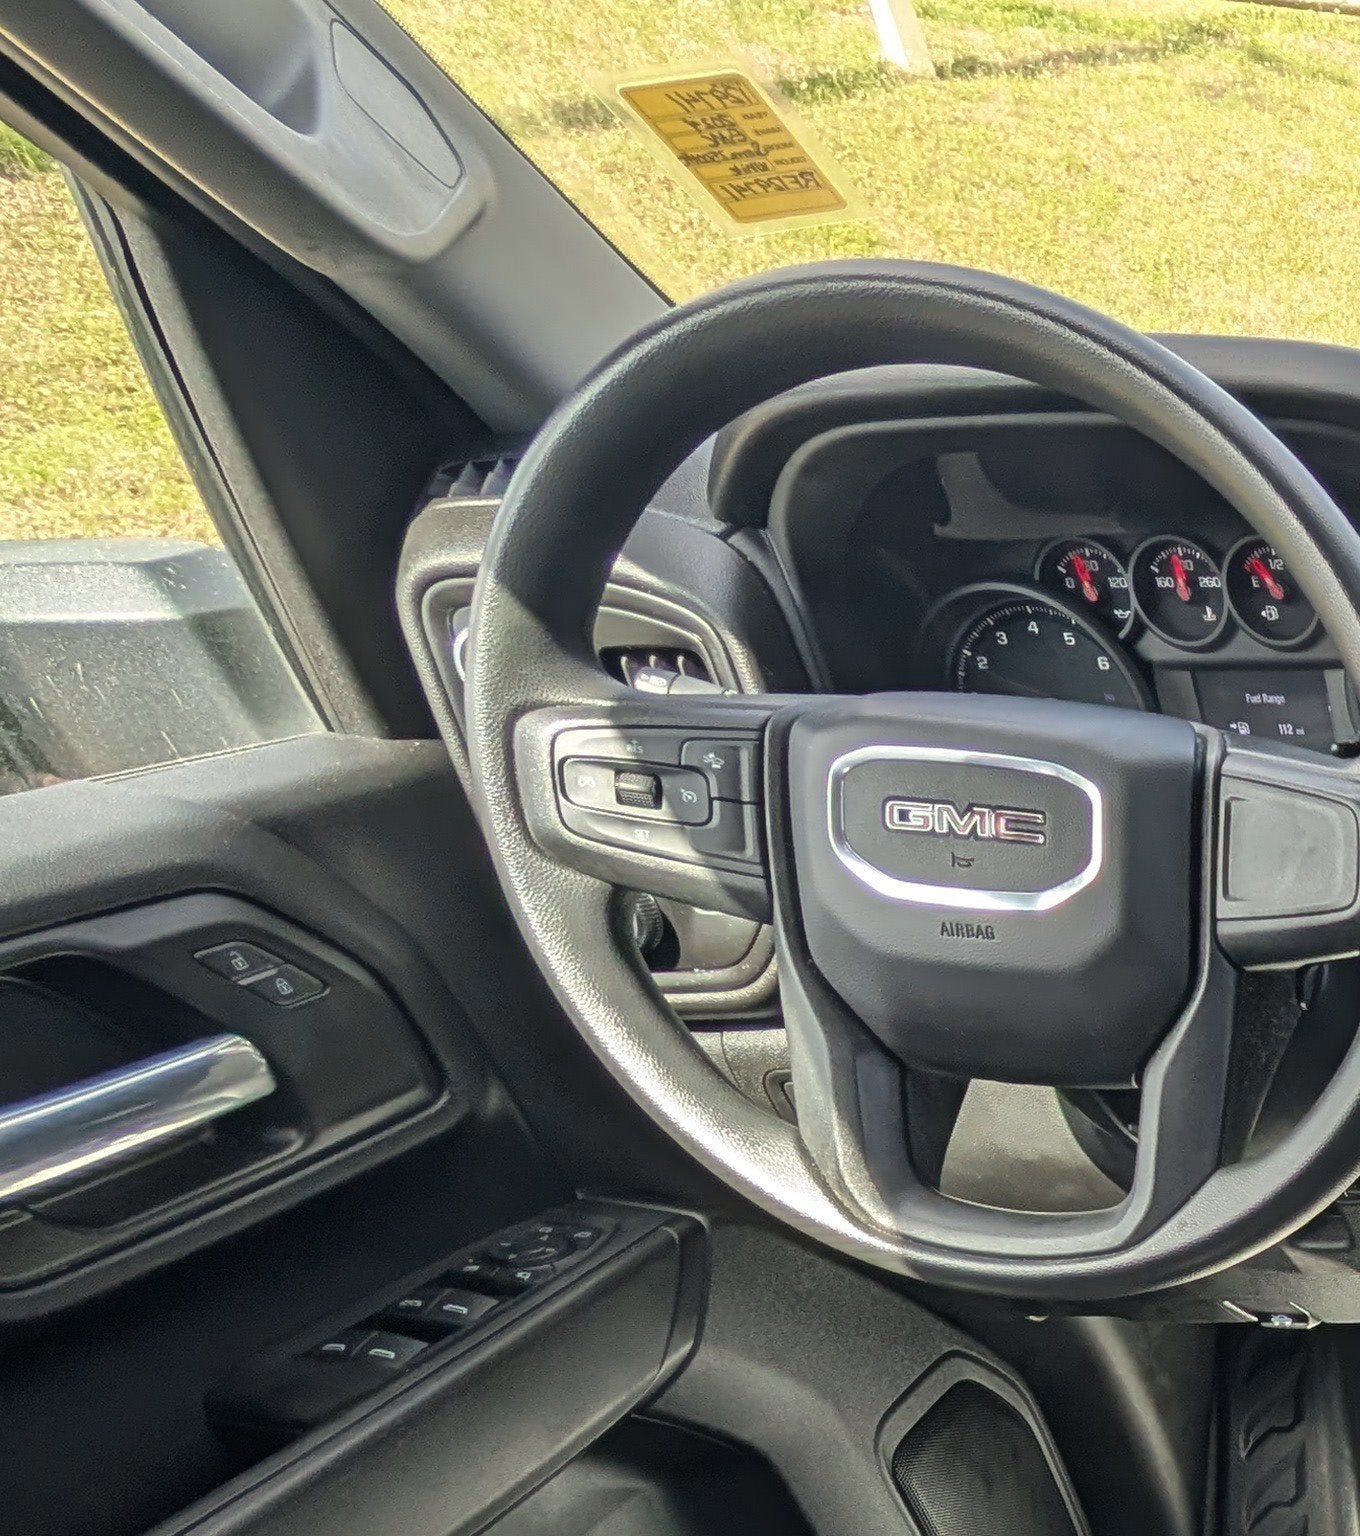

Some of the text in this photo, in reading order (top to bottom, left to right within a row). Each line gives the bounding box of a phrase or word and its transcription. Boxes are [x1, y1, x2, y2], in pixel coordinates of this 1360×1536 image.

[1108, 576, 1129, 589] 120
[1155, 576, 1175, 588] 160
[1199, 576, 1221, 588] 260
[1251, 576, 1260, 588] E
[1027, 620, 1039, 635] 4
[995, 631, 1008, 645] 3
[1063, 632, 1075, 645] 5
[976, 655, 989, 670] 2
[1097, 656, 1110, 670] 6
[1278, 724, 1294, 735] 112
[884, 798, 1046, 845] GMC
[940, 921, 996, 940] AIRBAG
